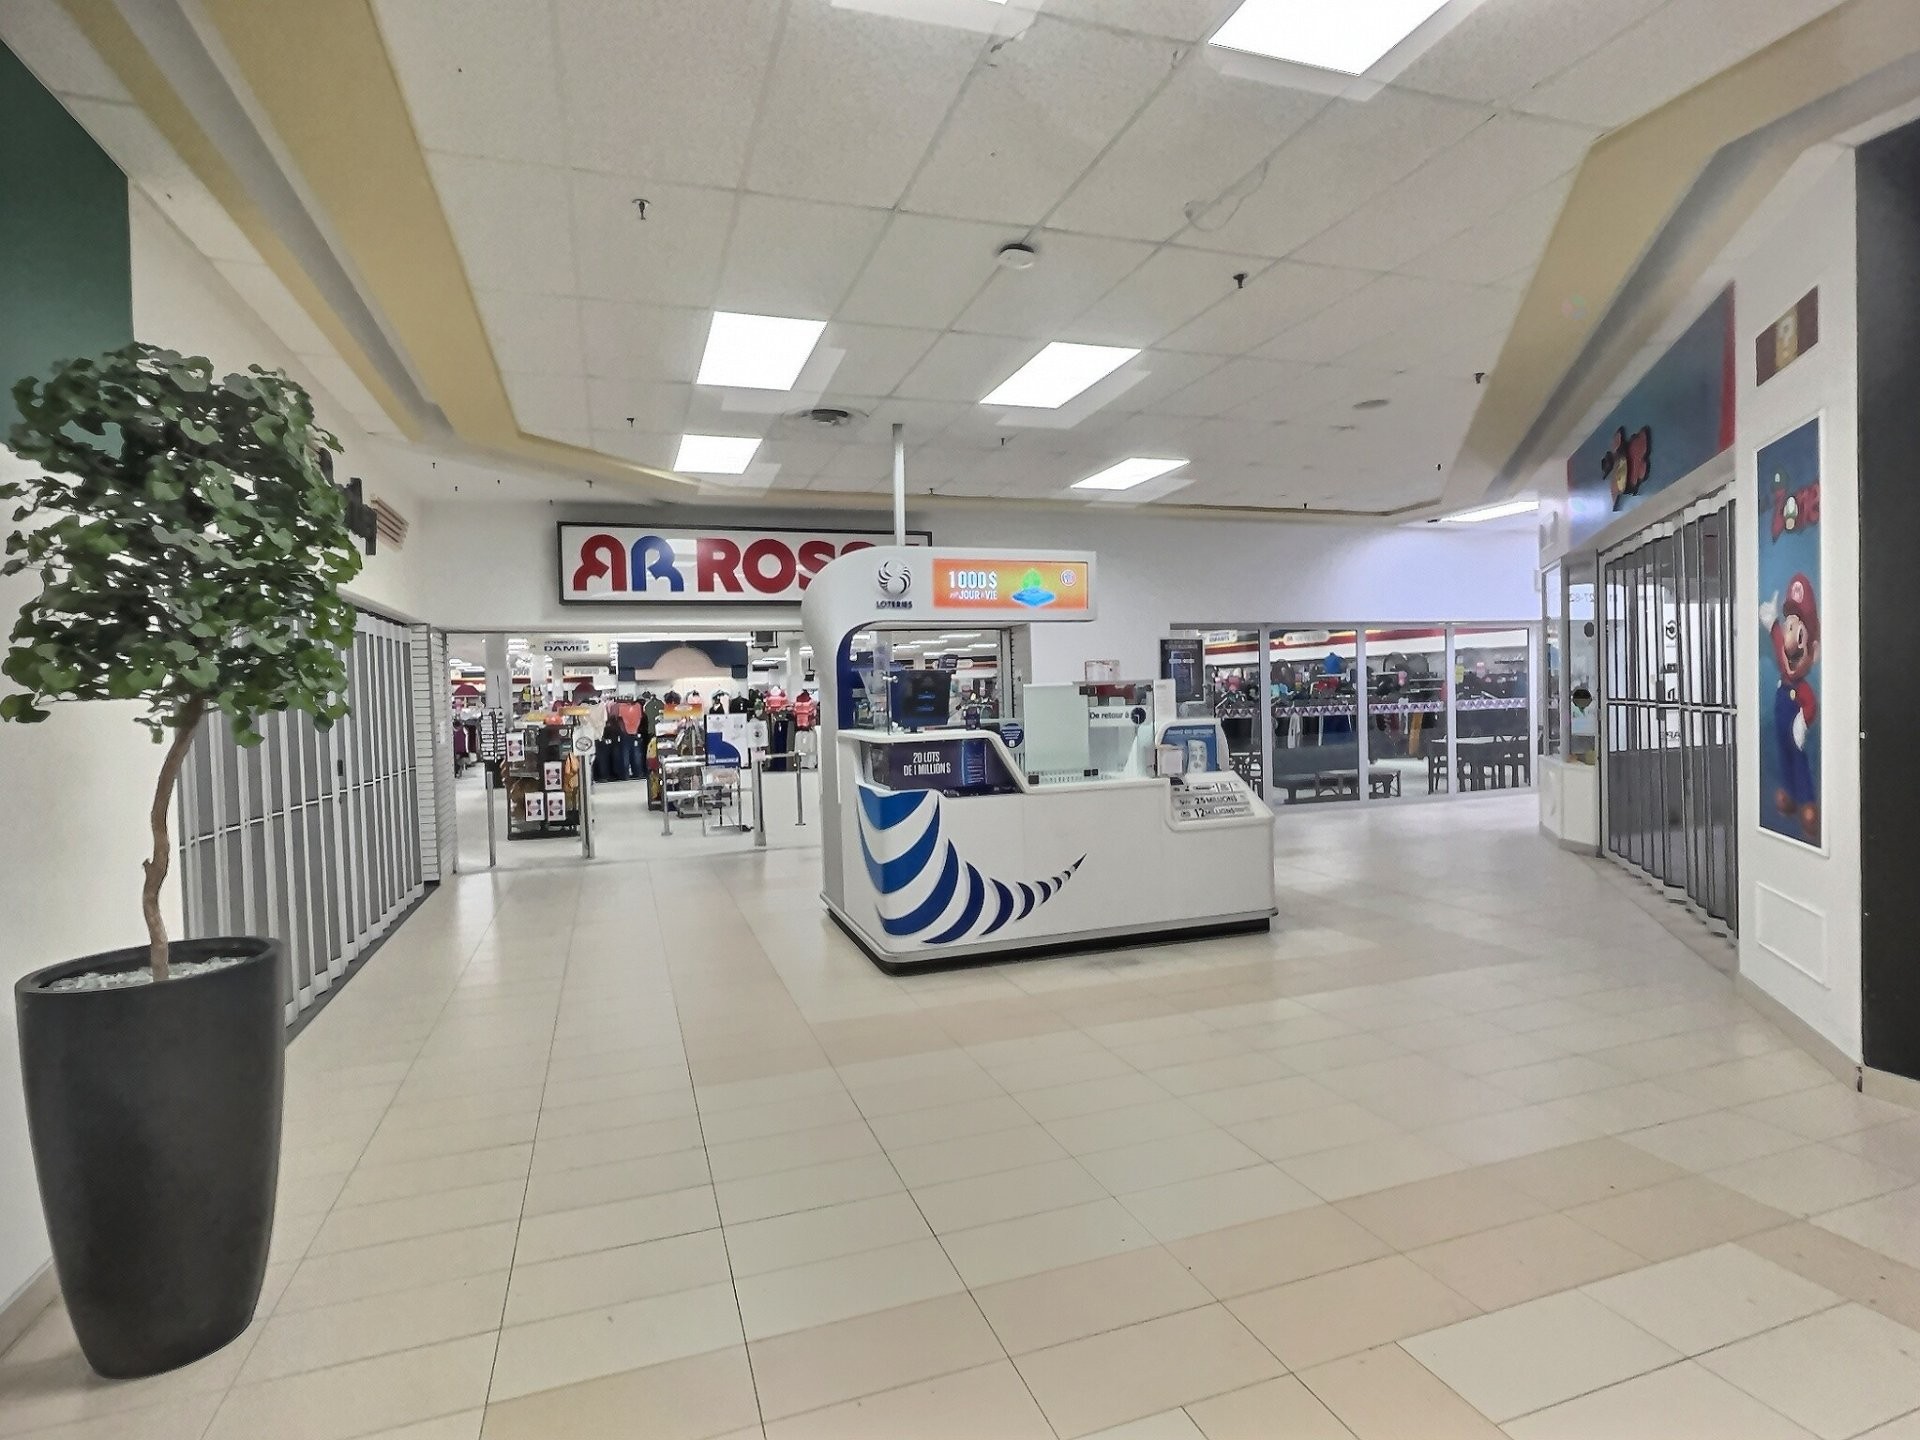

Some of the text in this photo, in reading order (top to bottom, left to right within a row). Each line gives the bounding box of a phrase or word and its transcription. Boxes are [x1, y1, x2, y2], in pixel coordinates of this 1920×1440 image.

[958, 590, 980, 600] JOUR
[985, 590, 998, 600] VIE
[1101, 711, 1123, 720] retour
[913, 751, 941, 764] 20 LOTS
[903, 764, 913, 777] DE
